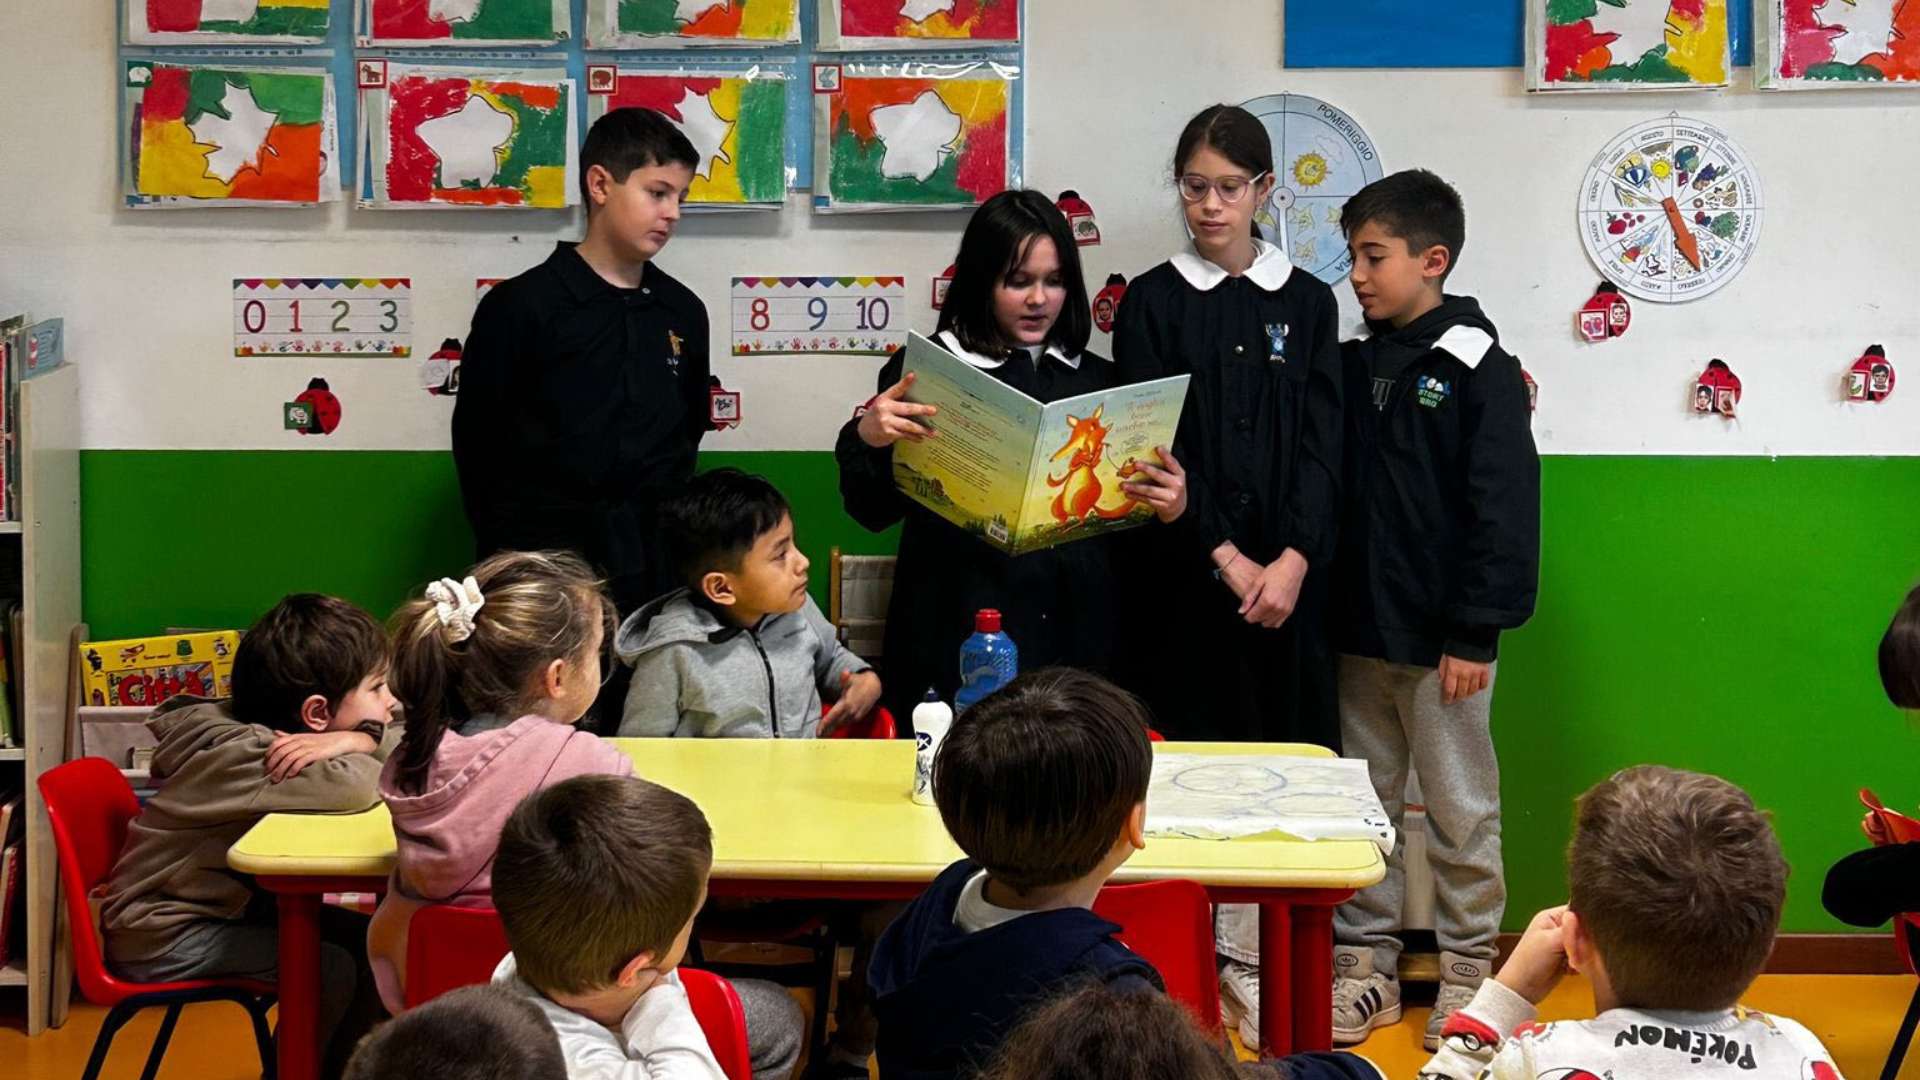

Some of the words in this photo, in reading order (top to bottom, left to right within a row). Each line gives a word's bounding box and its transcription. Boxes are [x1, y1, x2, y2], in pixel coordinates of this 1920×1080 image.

[1317, 103, 1374, 161] POMERIGGIO
[243, 300, 266, 333] 0
[289, 300, 303, 333] 1
[331, 300, 350, 333] 2
[379, 300, 398, 333] 3
[750, 297, 770, 331] 8
[807, 297, 828, 331] 9
[856, 297, 890, 331] 10
[1614, 1024, 1758, 1070] POKÉMON
